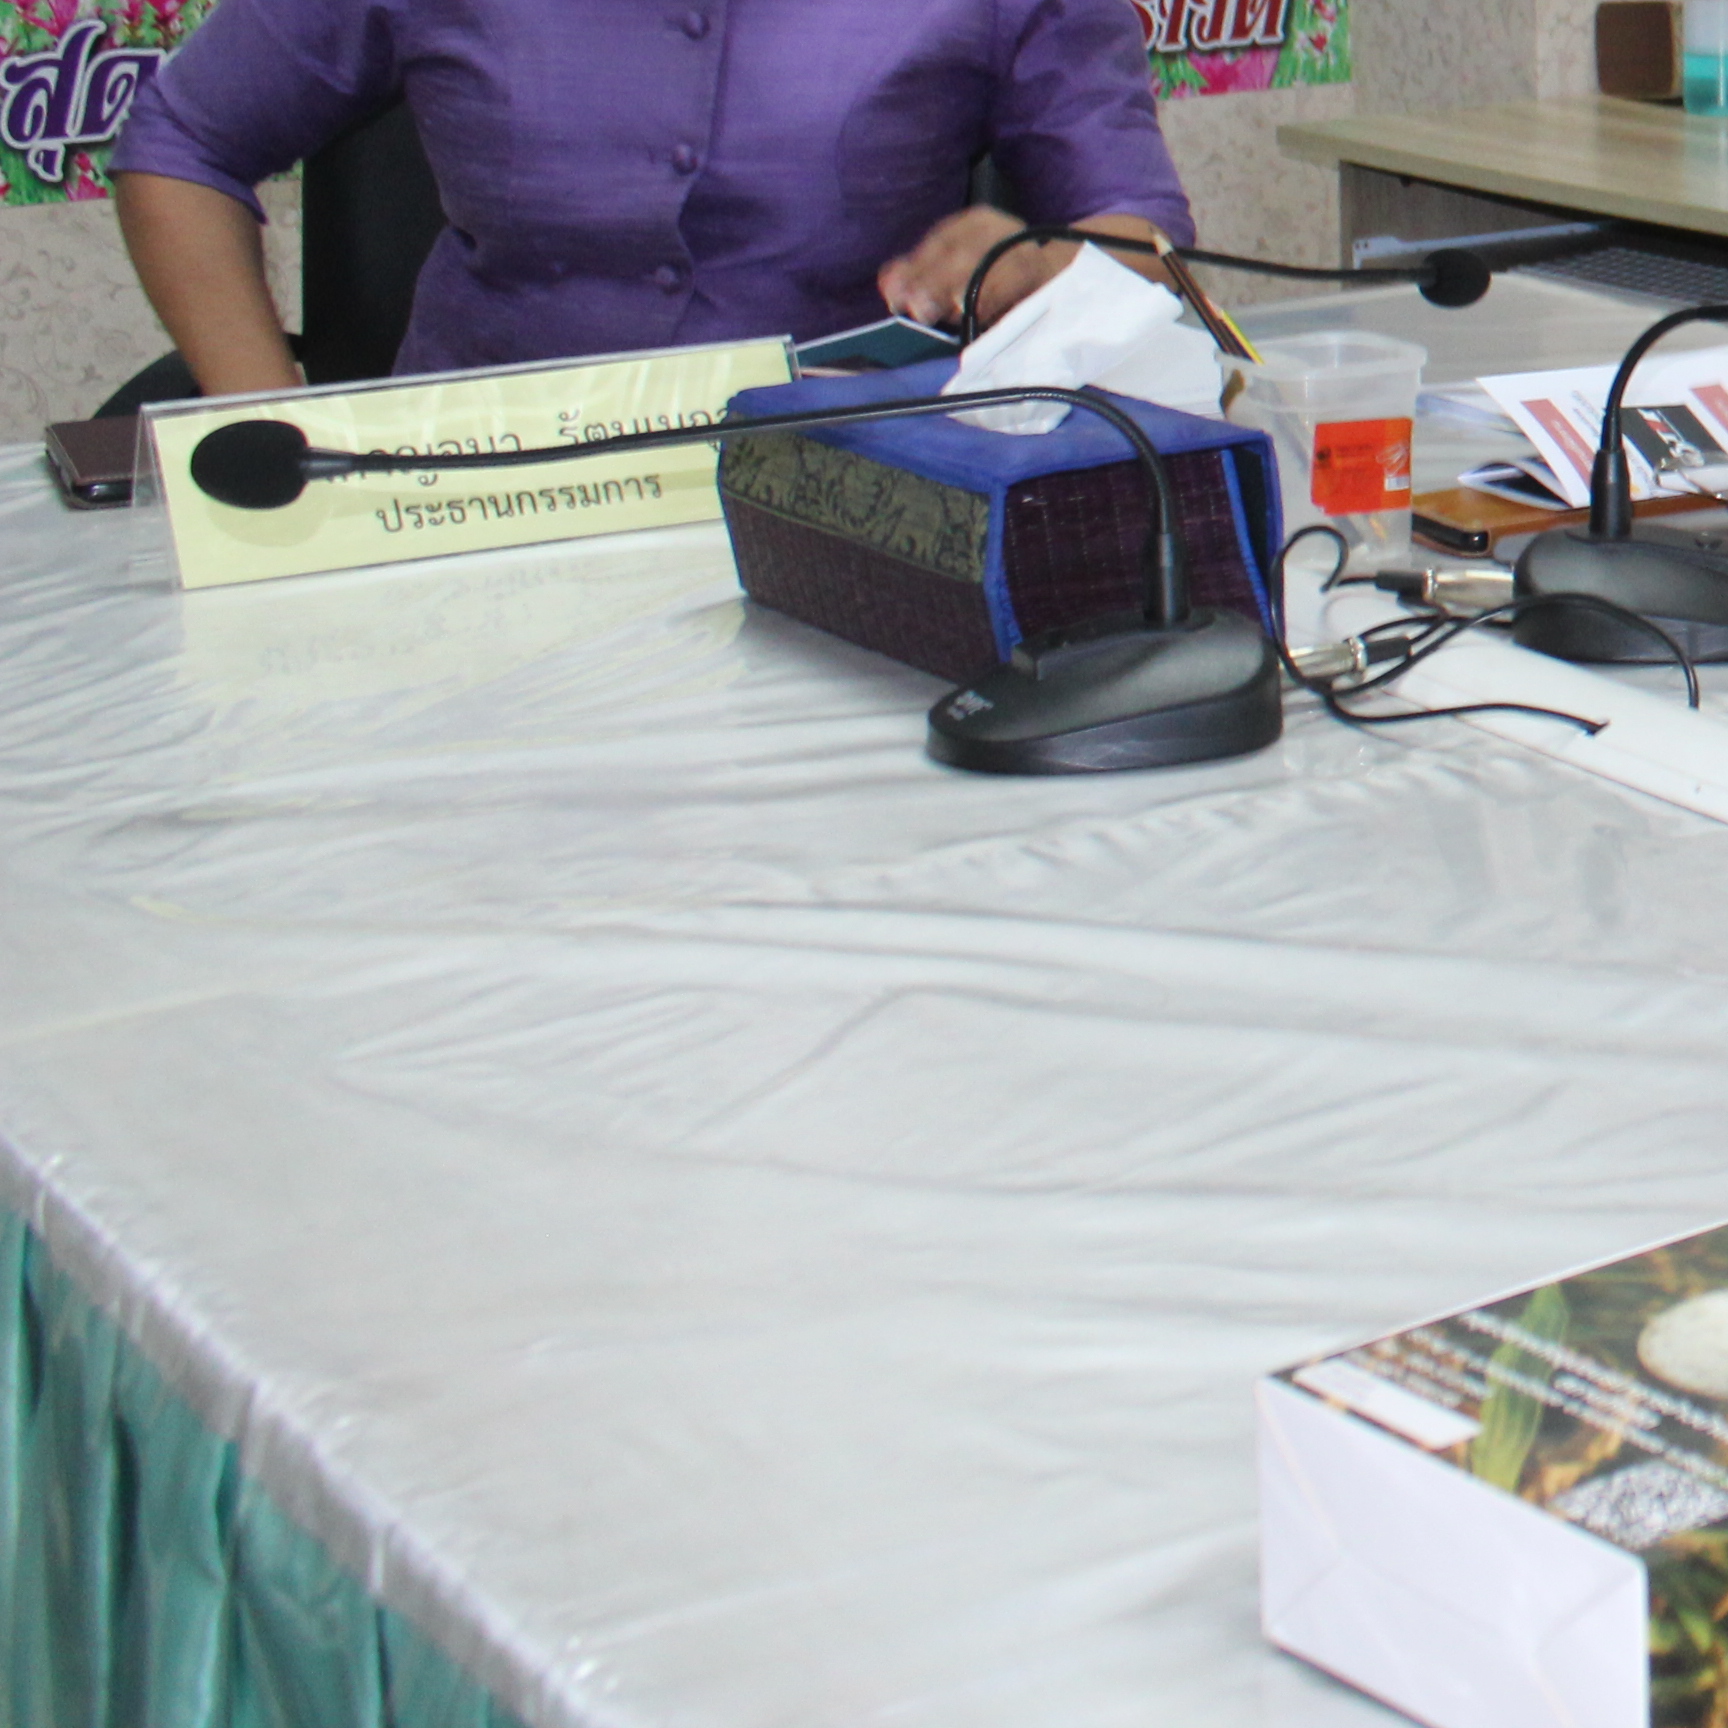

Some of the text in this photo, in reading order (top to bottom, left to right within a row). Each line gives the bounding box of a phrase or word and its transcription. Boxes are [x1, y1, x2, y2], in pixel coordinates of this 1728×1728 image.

[376, 472, 663, 534] ประธานกรรมการ
